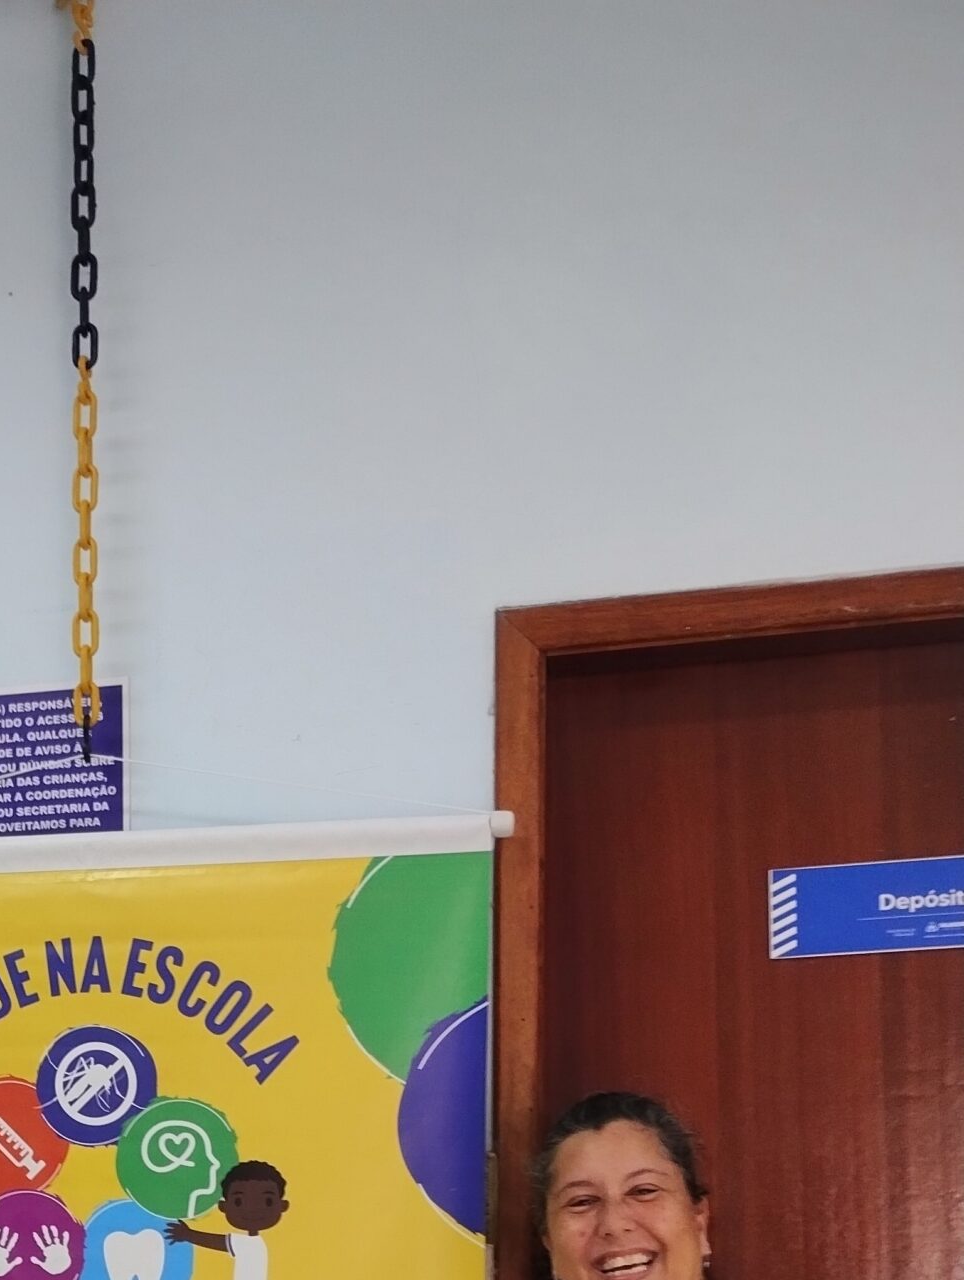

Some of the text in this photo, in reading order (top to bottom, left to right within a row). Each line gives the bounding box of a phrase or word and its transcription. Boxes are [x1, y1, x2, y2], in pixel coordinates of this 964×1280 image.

[8, 697, 103, 713] RESPONSÁEI
[24, 717, 34, 727] O
[27, 728, 92, 743] QUALQUE
[16, 748, 32, 758] DE
[34, 744, 71, 756] AVISO
[16, 776, 40, 787] DAS
[42, 771, 108, 785] CRIANÇAS,
[14, 792, 23, 802] A
[25, 784, 117, 801] COORDENAÇÃO
[15, 803, 91, 817] SECRETARIA
[93, 801, 110, 812] DA
[69, 817, 101, 828] PARA
[44, 935, 111, 997] NA
[121, 938, 300, 1085] ESCOLA
